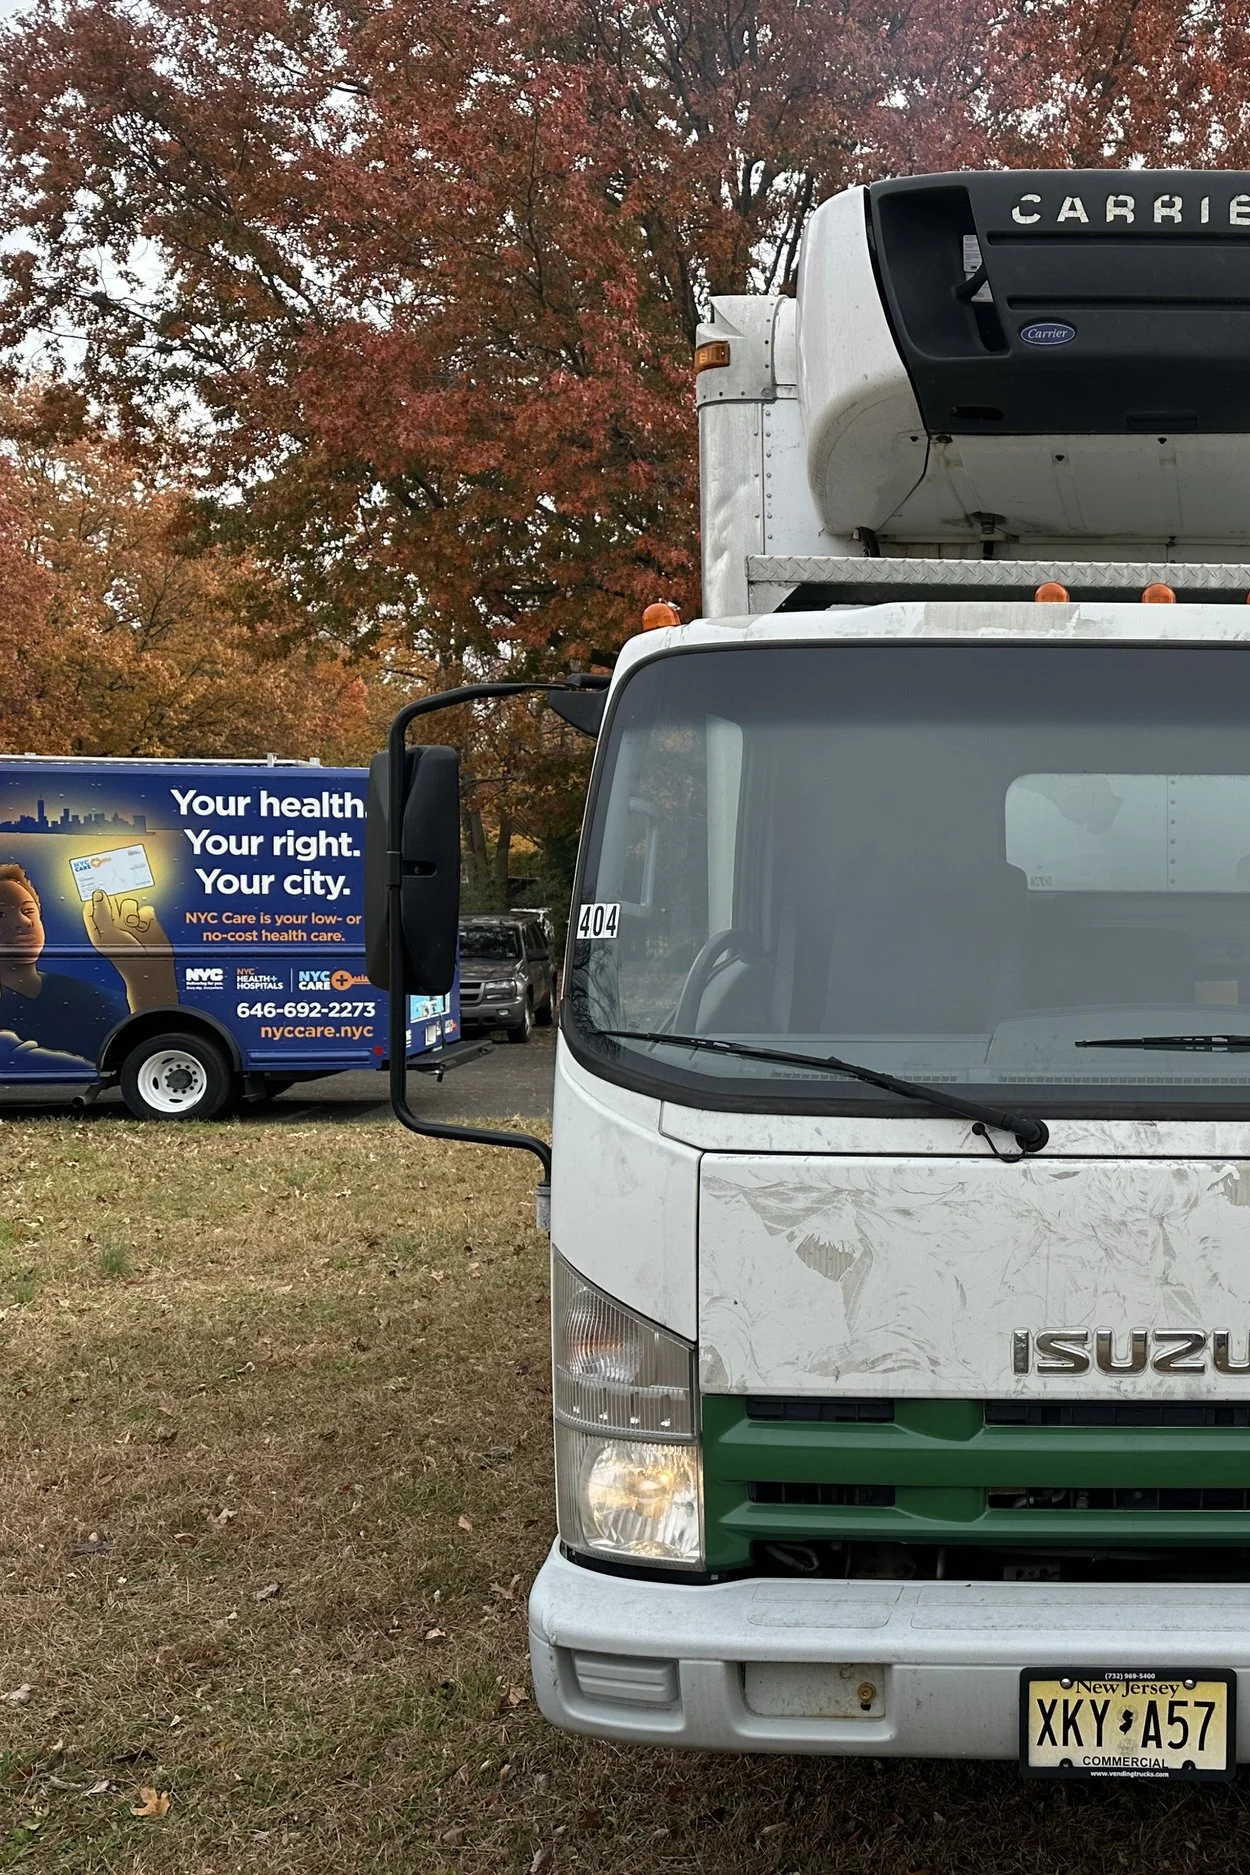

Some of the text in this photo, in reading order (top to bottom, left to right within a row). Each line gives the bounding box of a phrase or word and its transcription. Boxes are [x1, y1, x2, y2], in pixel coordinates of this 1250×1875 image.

[1027, 328, 1069, 340] Carrier
[170, 789, 367, 818] Your health
[183, 829, 361, 861] Your right.
[195, 868, 351, 900] Your city.
[185, 912, 362, 926] NYC Care is your low- or
[580, 906, 617, 937] 404
[203, 929, 345, 941] no-cost health care.
[185, 968, 224, 982] NYC
[298, 970, 330, 982] NYC
[236, 982, 283, 990] HOSPITALS
[298, 981, 331, 991] CARE
[237, 1002, 376, 1018] 646-692-2273
[260, 1025, 374, 1040] nyccare.nyc
[1104, 1673, 1123, 1681] (732)
[1076, 1680, 1180, 1698] New Jersey
[1036, 1699, 1216, 1751] XKY A57
[1082, 1755, 1169, 1769] COMMERCIAL
[1090, 1770, 1169, 1779] www.vendingtrucks.com
